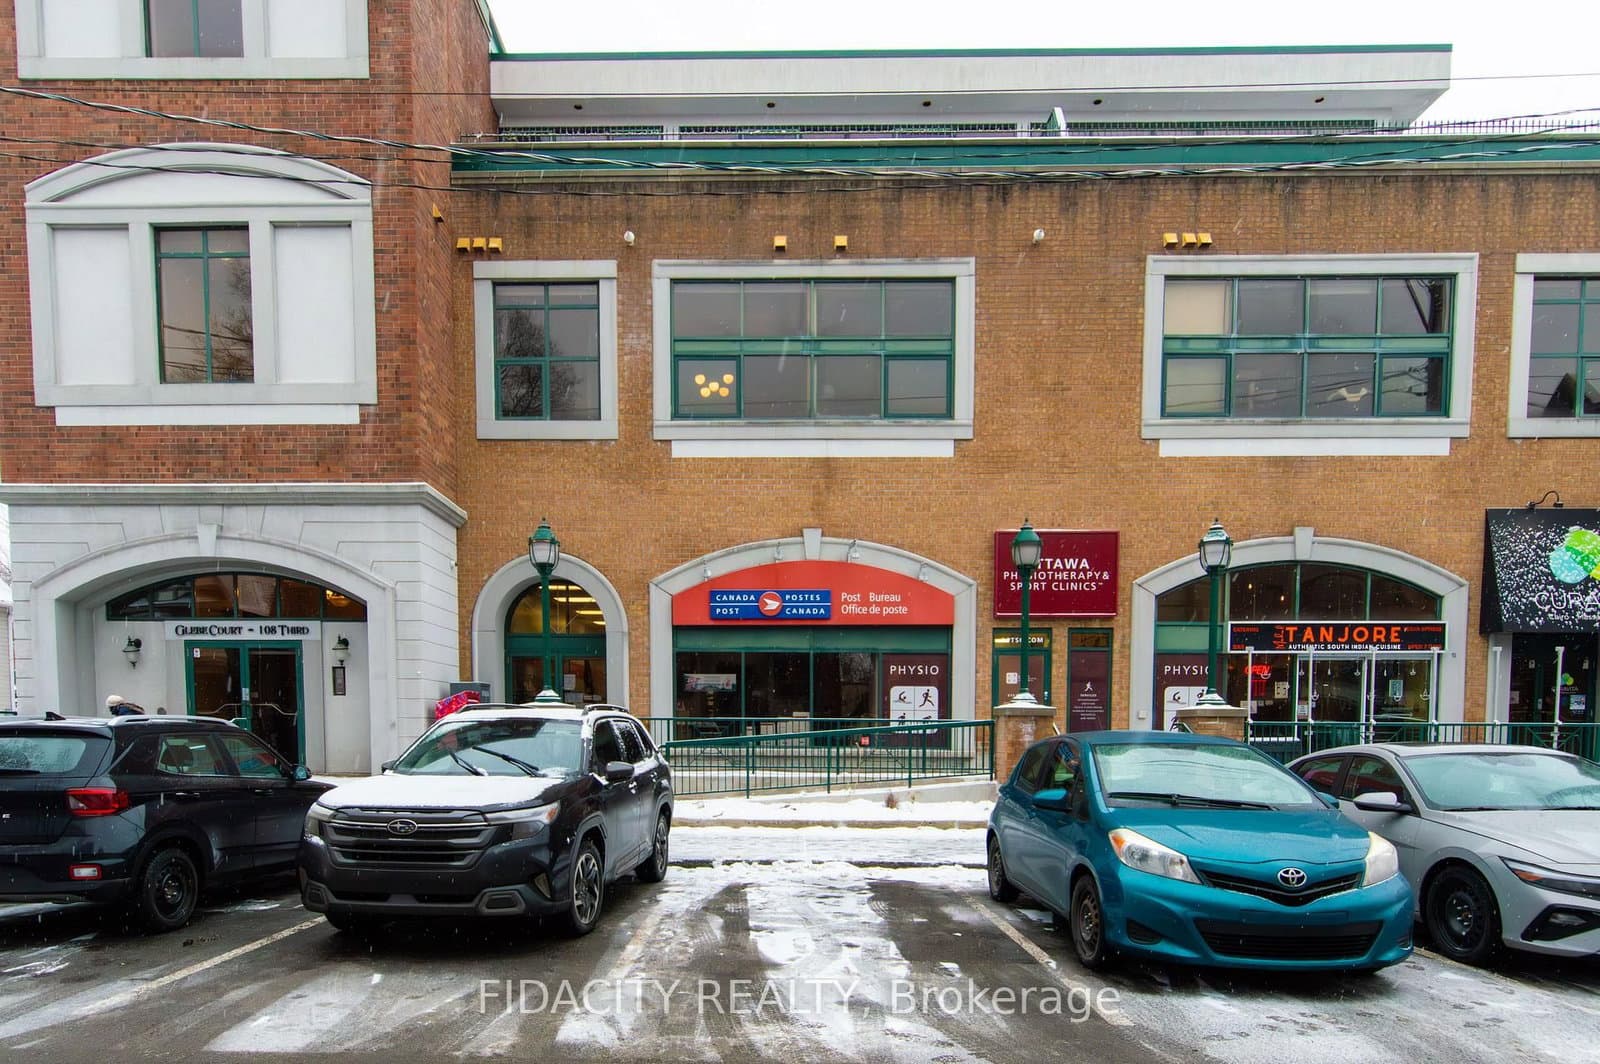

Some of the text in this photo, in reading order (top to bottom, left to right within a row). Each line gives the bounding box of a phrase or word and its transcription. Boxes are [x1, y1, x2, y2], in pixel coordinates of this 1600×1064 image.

[1003, 571, 1101, 581] PHIOTHERAPY
[1010, 582, 1097, 591] SPRT CLINICS
[841, 592, 901, 602] Post Bureau
[716, 607, 740, 615] POST
[785, 607, 826, 615] CANADA
[841, 604, 909, 617] Office de poste
[259, 624, 277, 636] 108
[1285, 626, 1401, 643] TANJORE
[889, 665, 940, 675] PHYSIO
